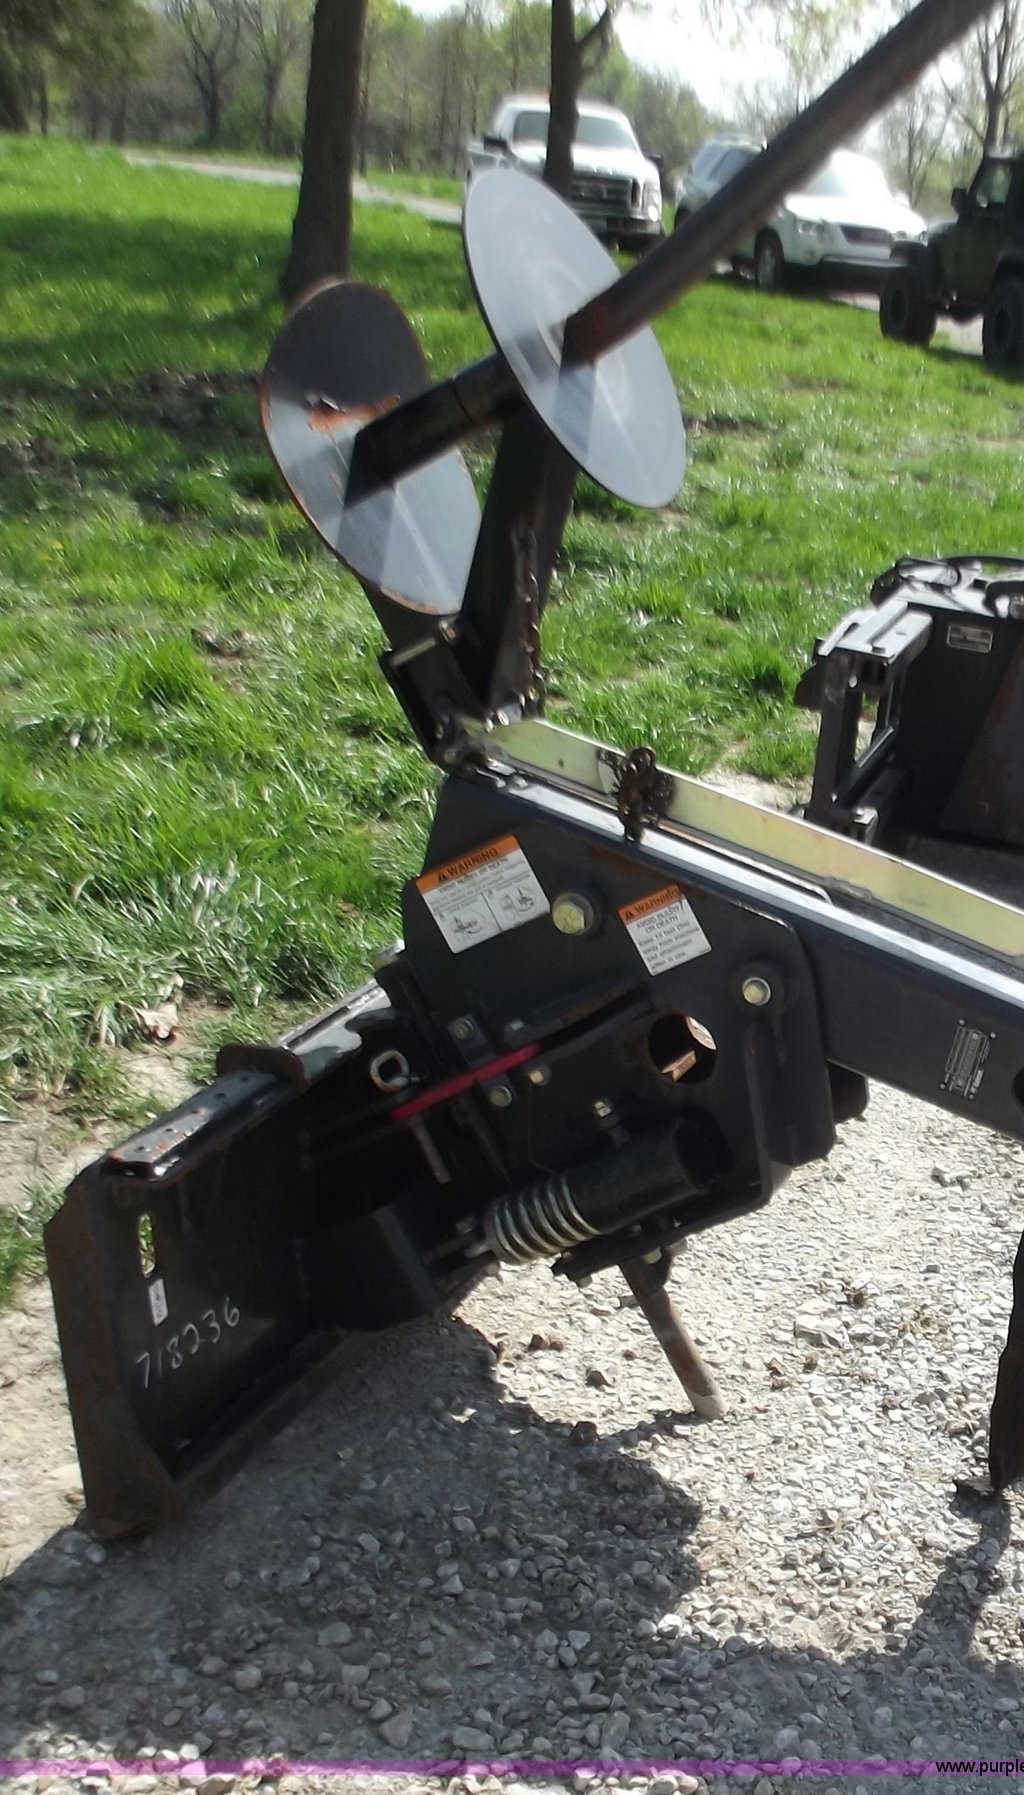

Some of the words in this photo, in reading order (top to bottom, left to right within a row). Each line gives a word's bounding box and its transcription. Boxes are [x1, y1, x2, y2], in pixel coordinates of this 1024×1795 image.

[447, 846, 499, 878] WARNING
[635, 886, 679, 912] WARNING
[656, 915, 679, 929] DEATH
[135, 1296, 240, 1389] 718236
